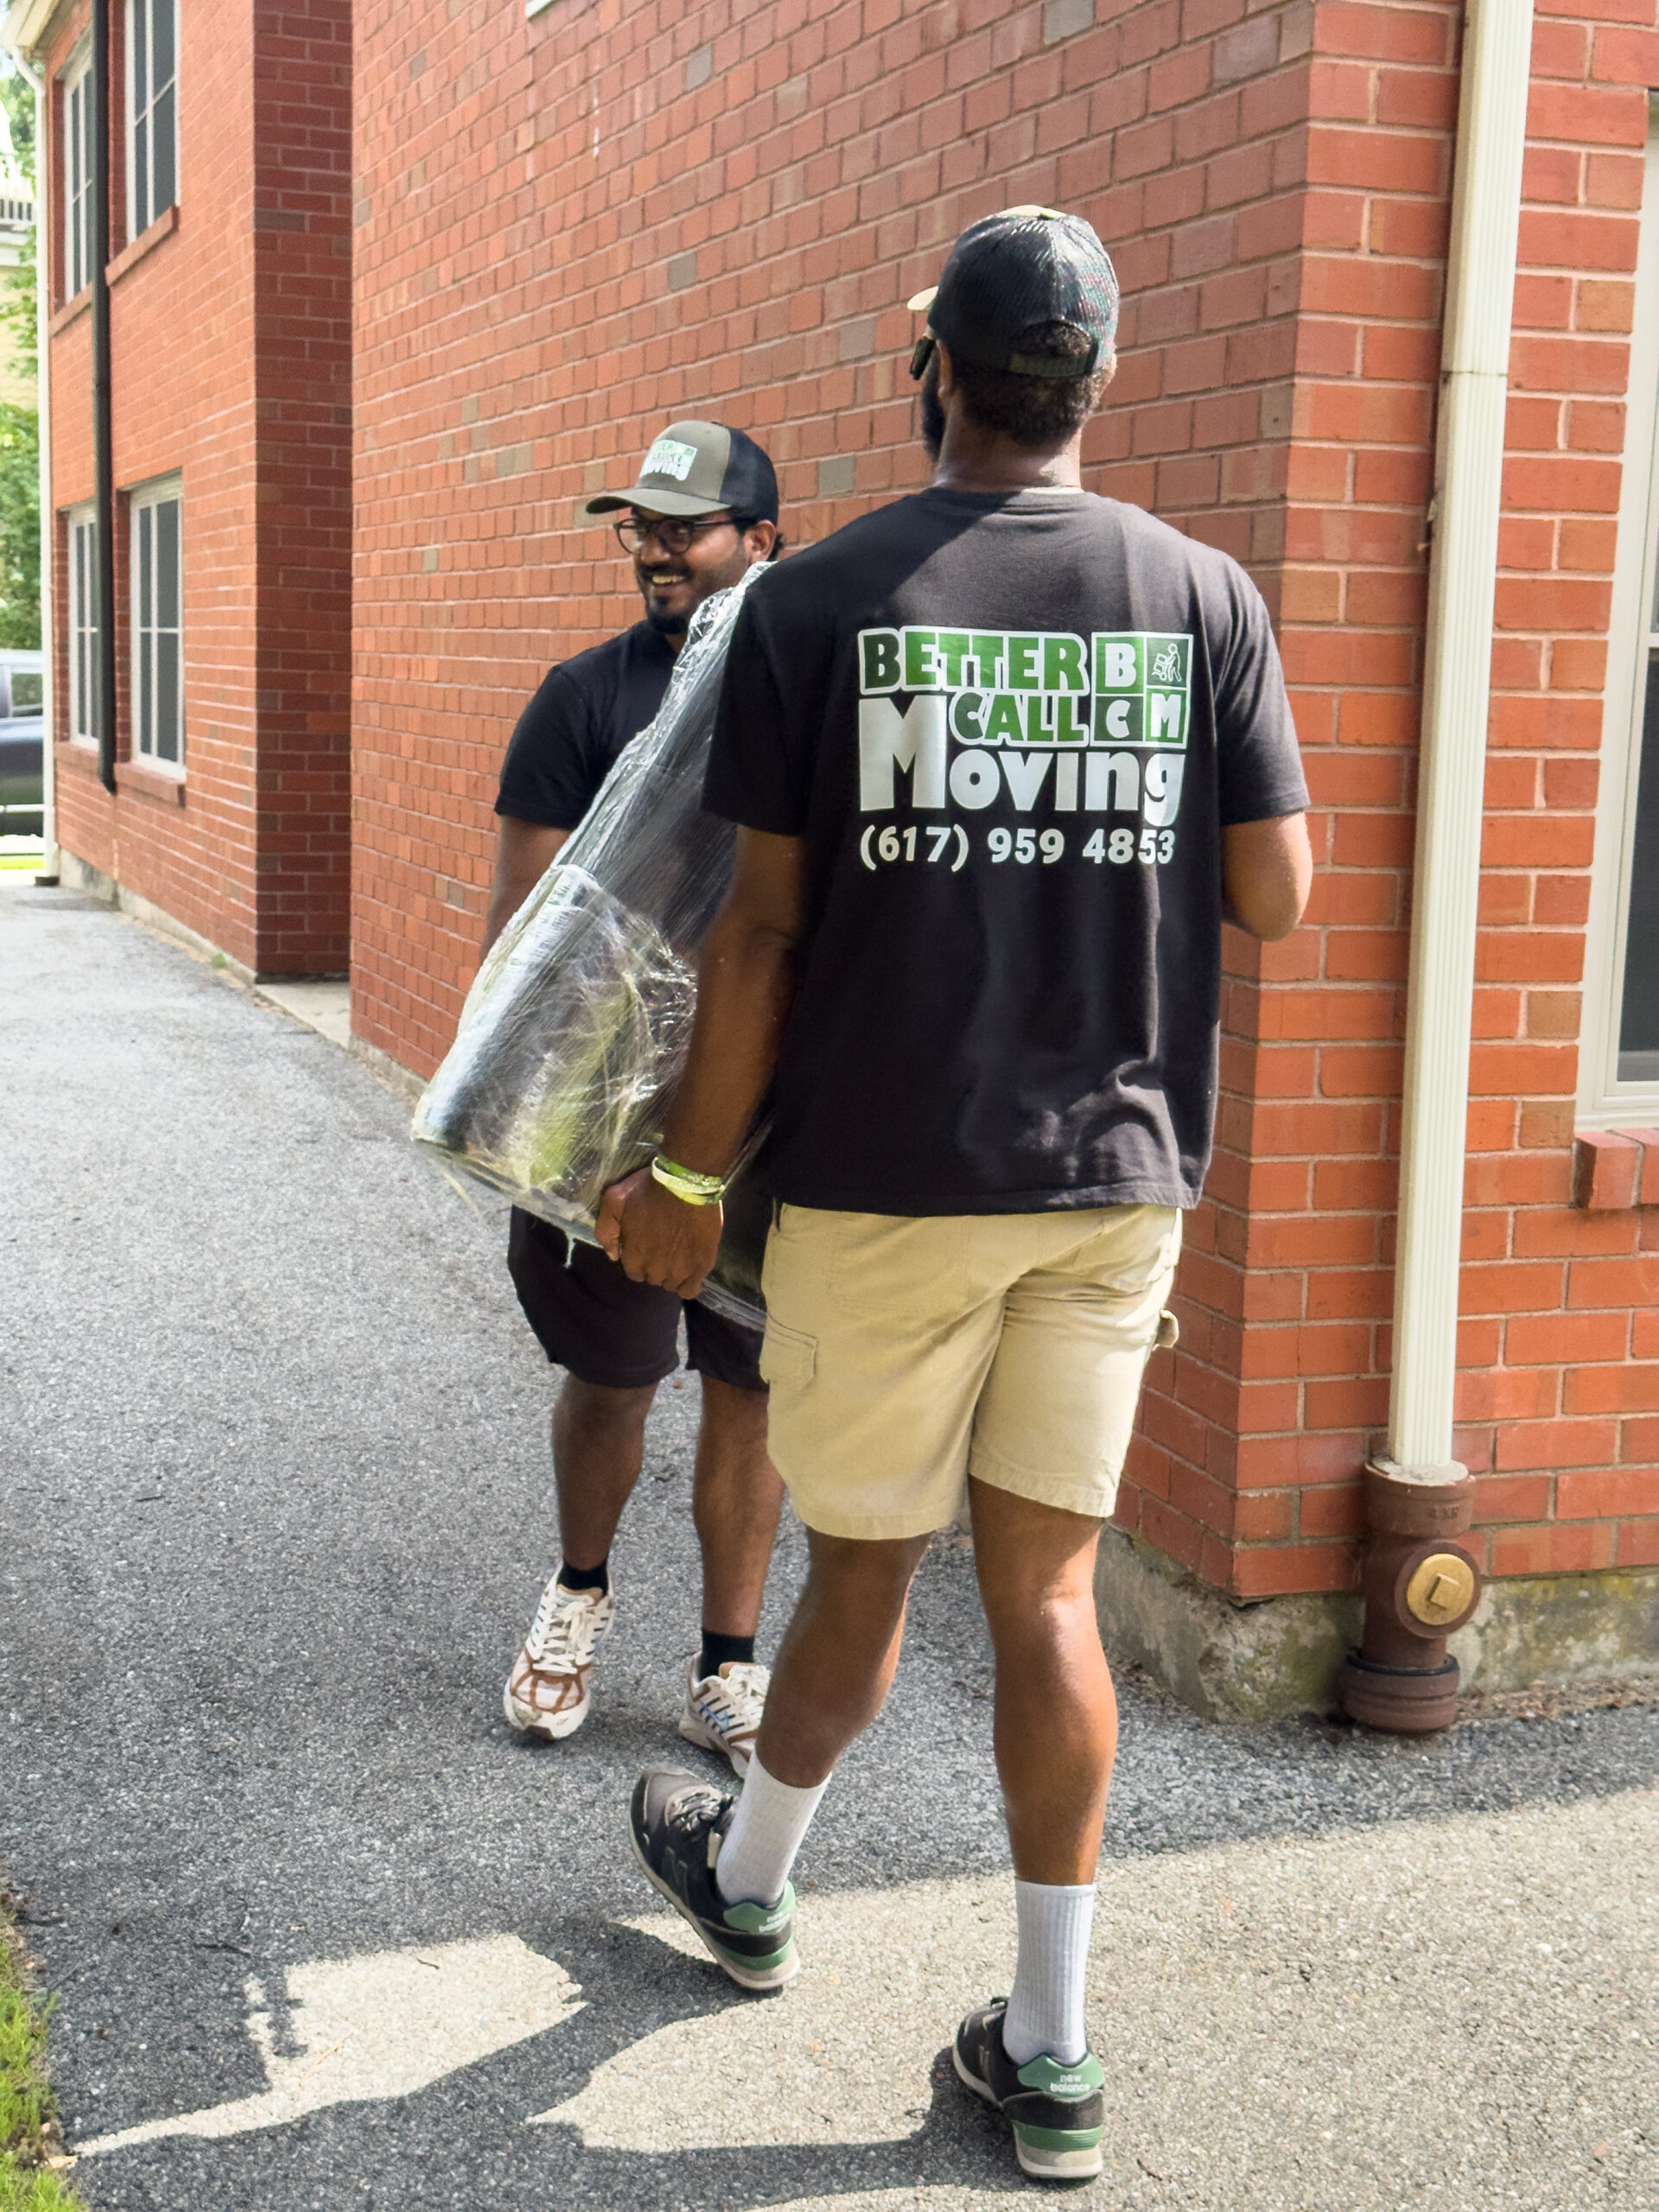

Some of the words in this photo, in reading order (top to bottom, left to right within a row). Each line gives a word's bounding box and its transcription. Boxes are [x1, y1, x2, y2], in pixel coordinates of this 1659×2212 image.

[861, 628, 1088, 692] BETTER
[953, 692, 1084, 742] CALL
[859, 695, 1185, 827] Moving
[860, 823, 969, 872] (617)
[987, 828, 1065, 864] 959
[1083, 828, 1176, 865] 4853
[1050, 2082, 1090, 2092] balance
[1060, 2074, 1082, 2082] new
